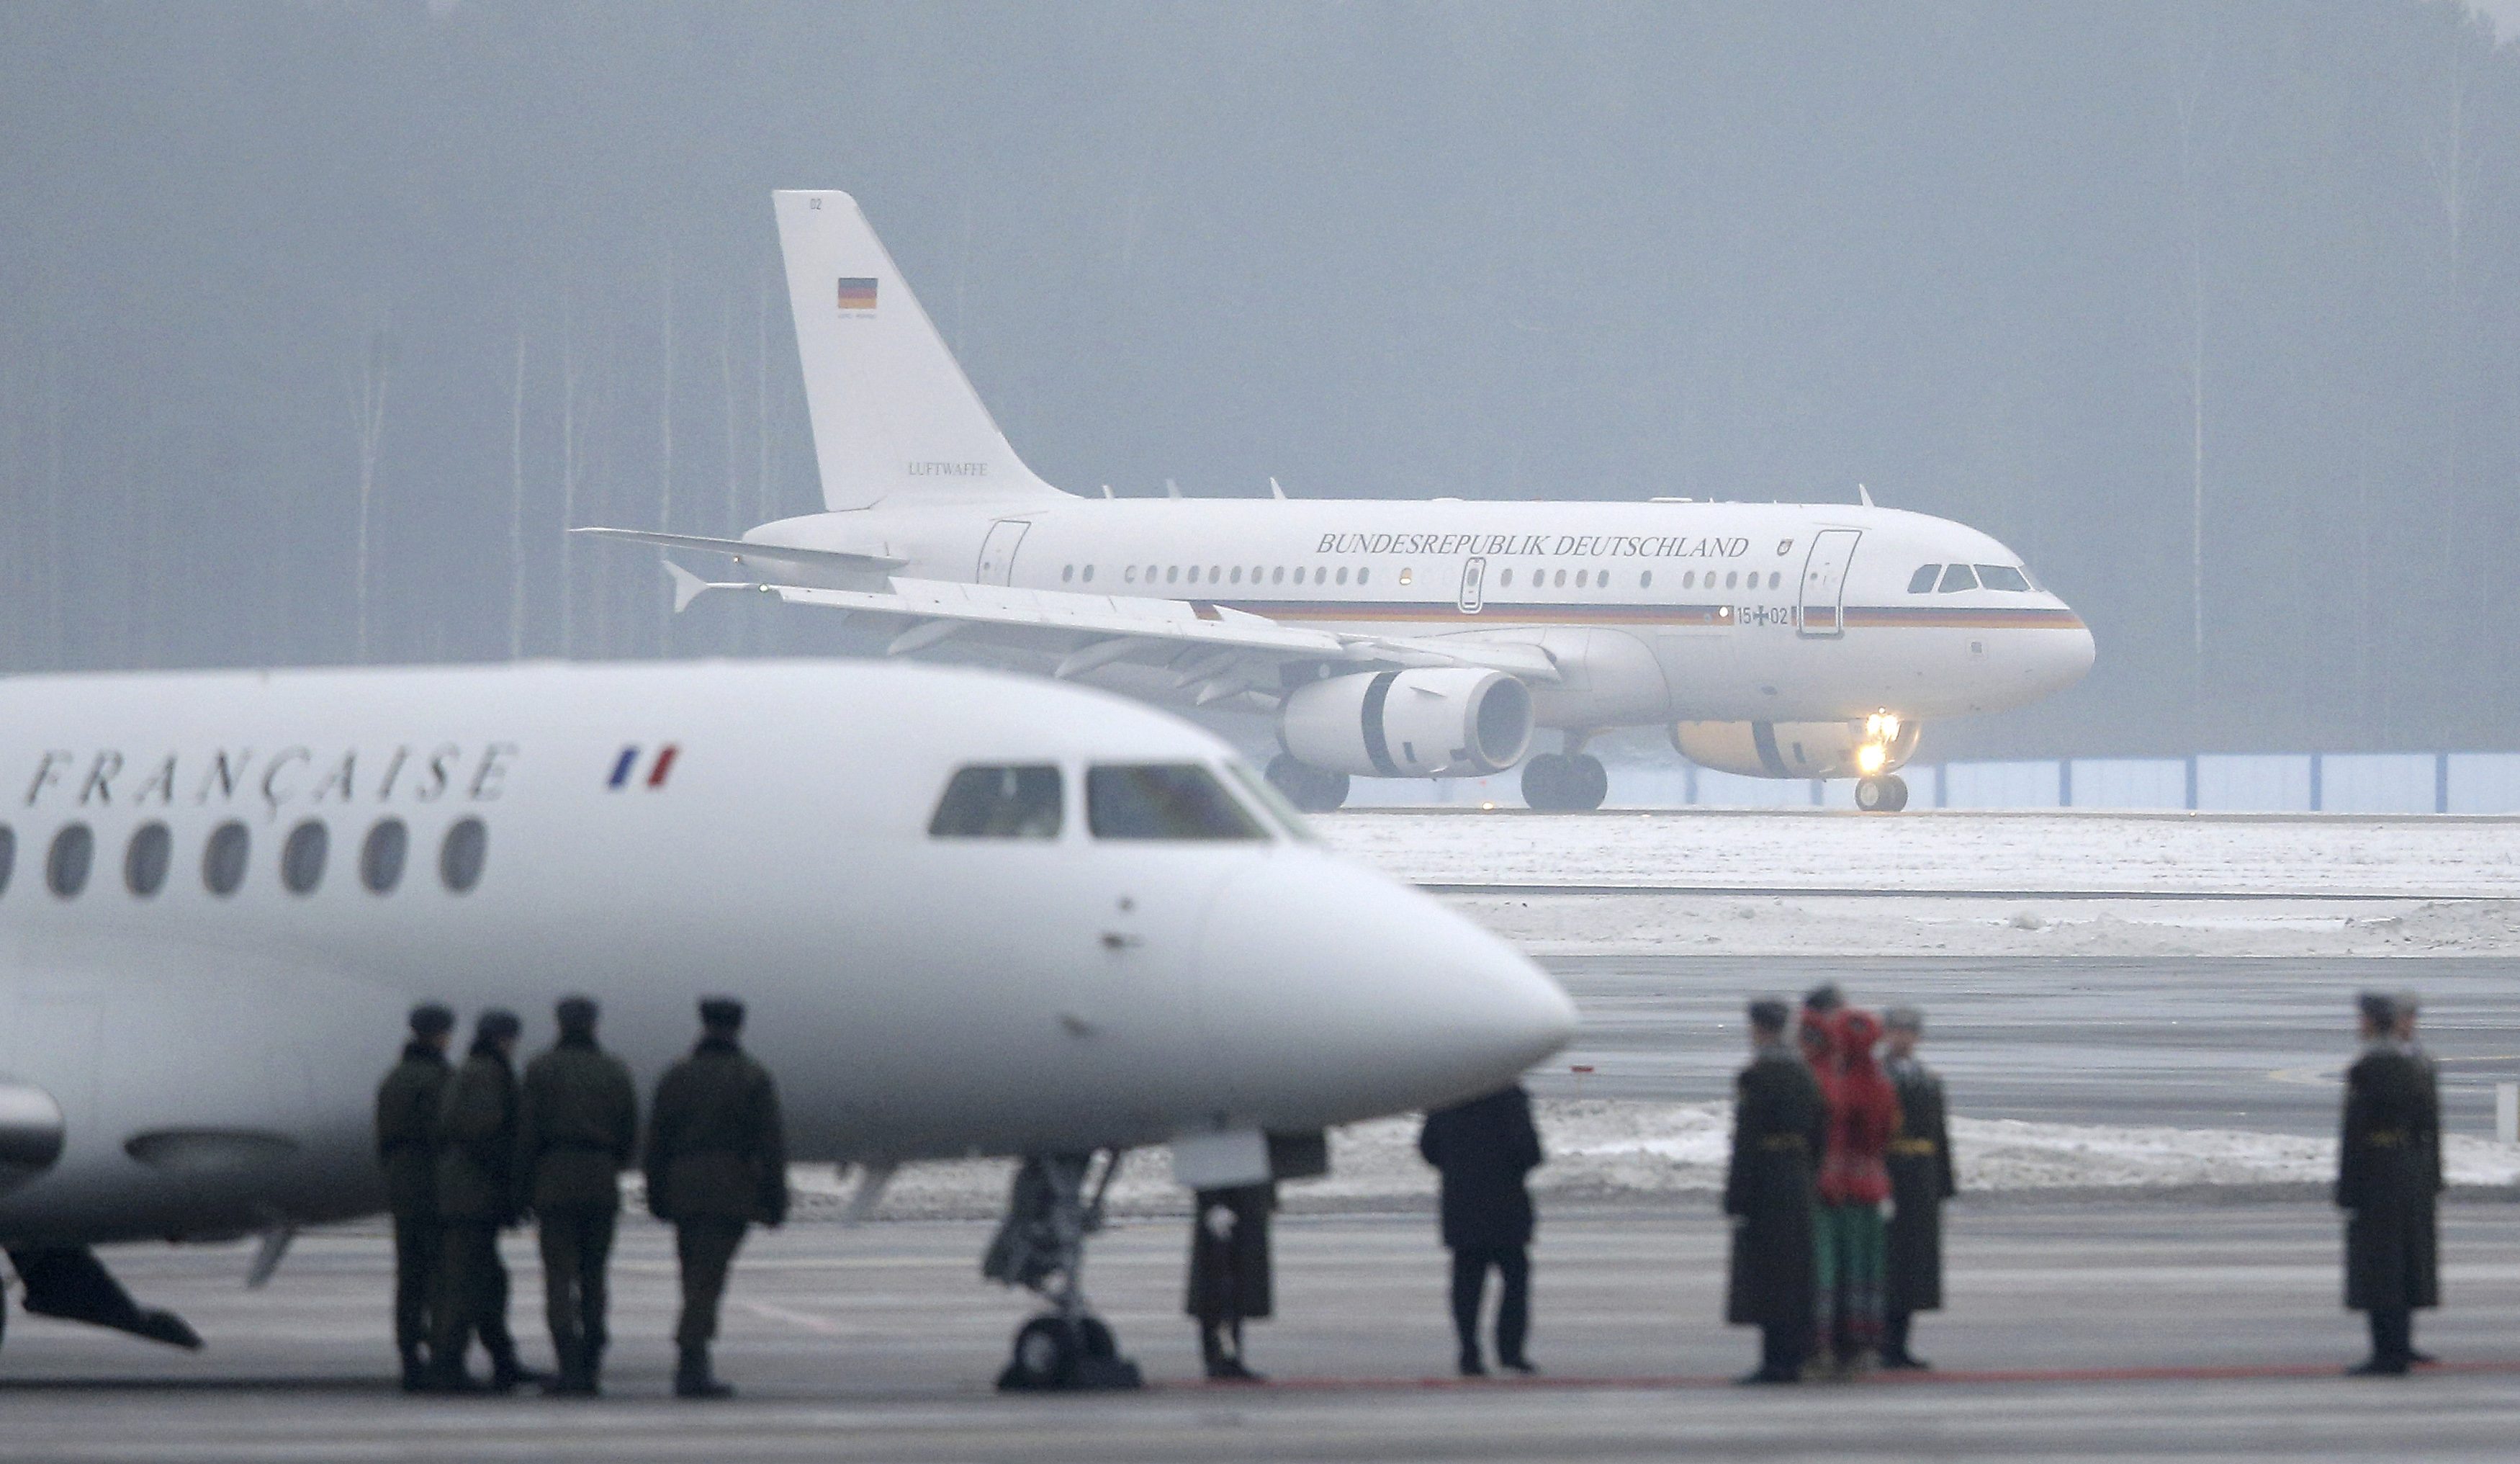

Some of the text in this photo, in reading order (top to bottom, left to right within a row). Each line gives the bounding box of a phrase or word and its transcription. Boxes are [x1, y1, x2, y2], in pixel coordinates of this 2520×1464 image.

[810, 198, 822, 210] 02
[909, 462, 988, 476] LUFTWAFFE
[1315, 533, 1750, 559] BUNDESREPUBLIK DEUTSCHLAND
[25, 742, 518, 821] FRANÇAISE
